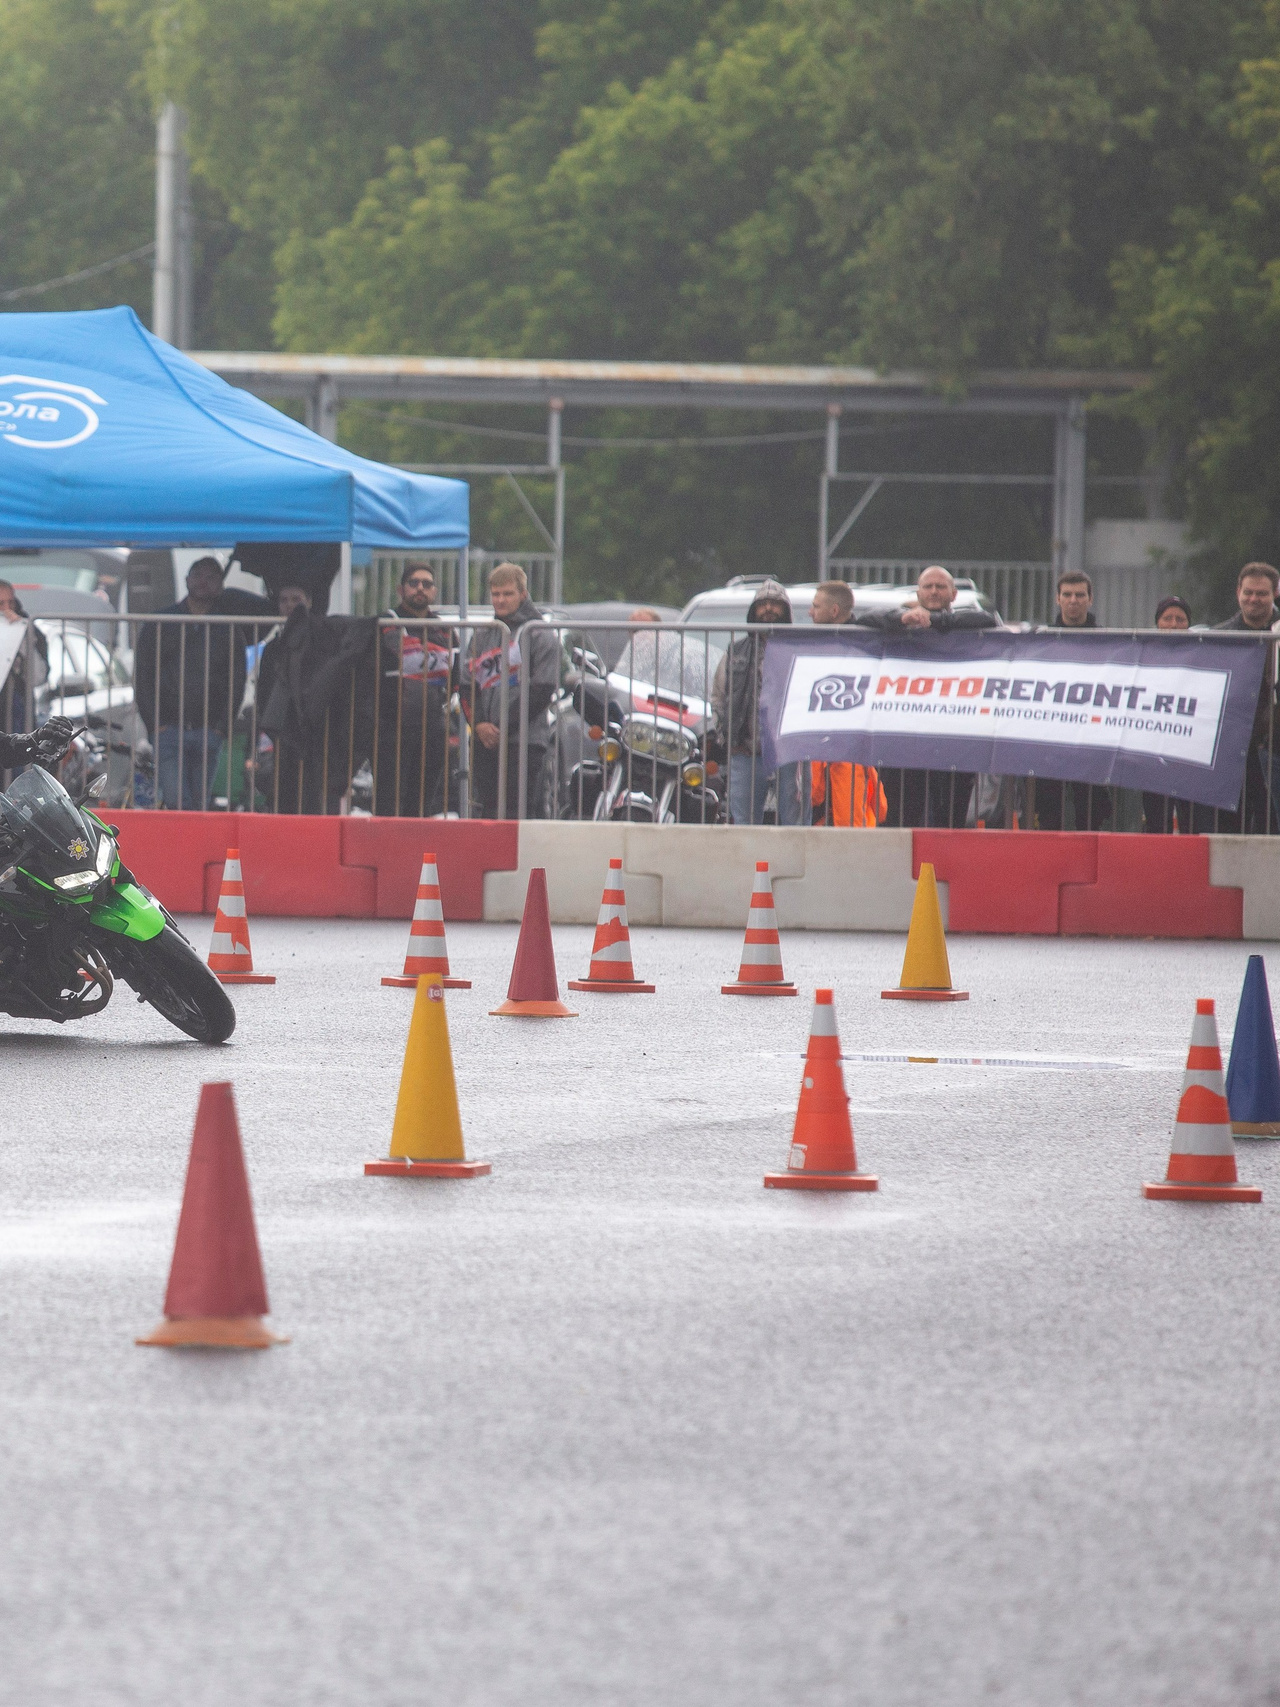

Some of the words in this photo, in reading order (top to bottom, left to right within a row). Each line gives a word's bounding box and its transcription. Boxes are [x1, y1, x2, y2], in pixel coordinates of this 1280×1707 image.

[875, 675, 1198, 717] MOTOREMONT.RU
[871, 701, 977, 715] МОТОМАГАЗИН
[993, 707, 1089, 724] МОТОСЕРВИС
[1105, 716, 1194, 737] МОТОСАЛОН
